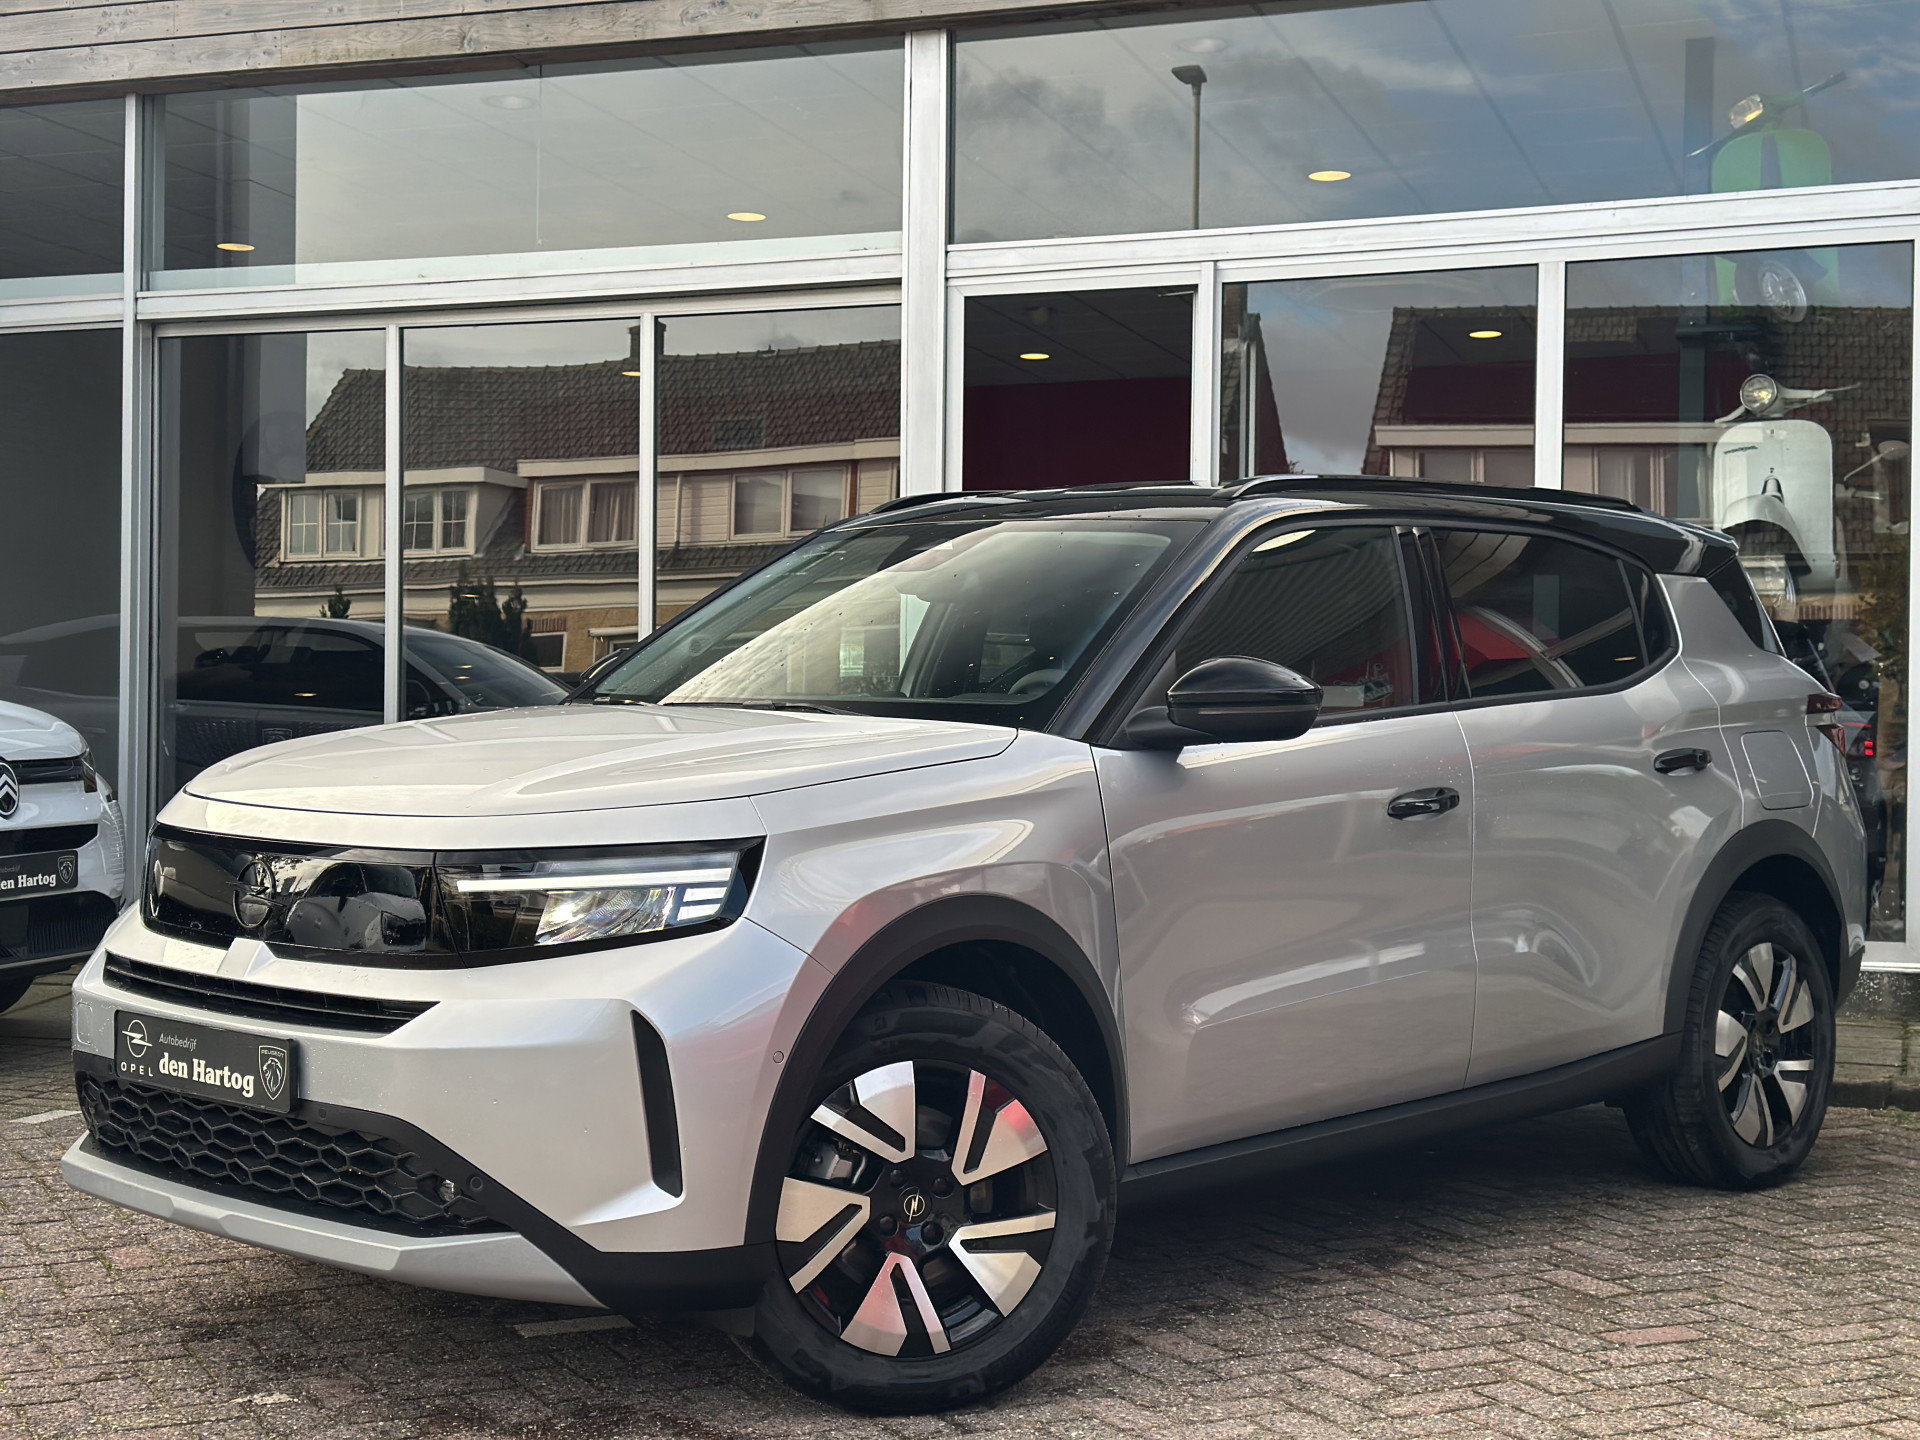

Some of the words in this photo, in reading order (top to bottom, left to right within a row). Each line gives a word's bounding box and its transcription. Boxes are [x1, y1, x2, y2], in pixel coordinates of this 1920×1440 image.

[0, 880, 15, 890] en
[17, 873, 56, 887] Hartog
[159, 1033, 197, 1051] Autobedrijf
[120, 1061, 153, 1077] OPEL
[159, 1052, 188, 1078] den
[192, 1058, 255, 1098] Hartog
